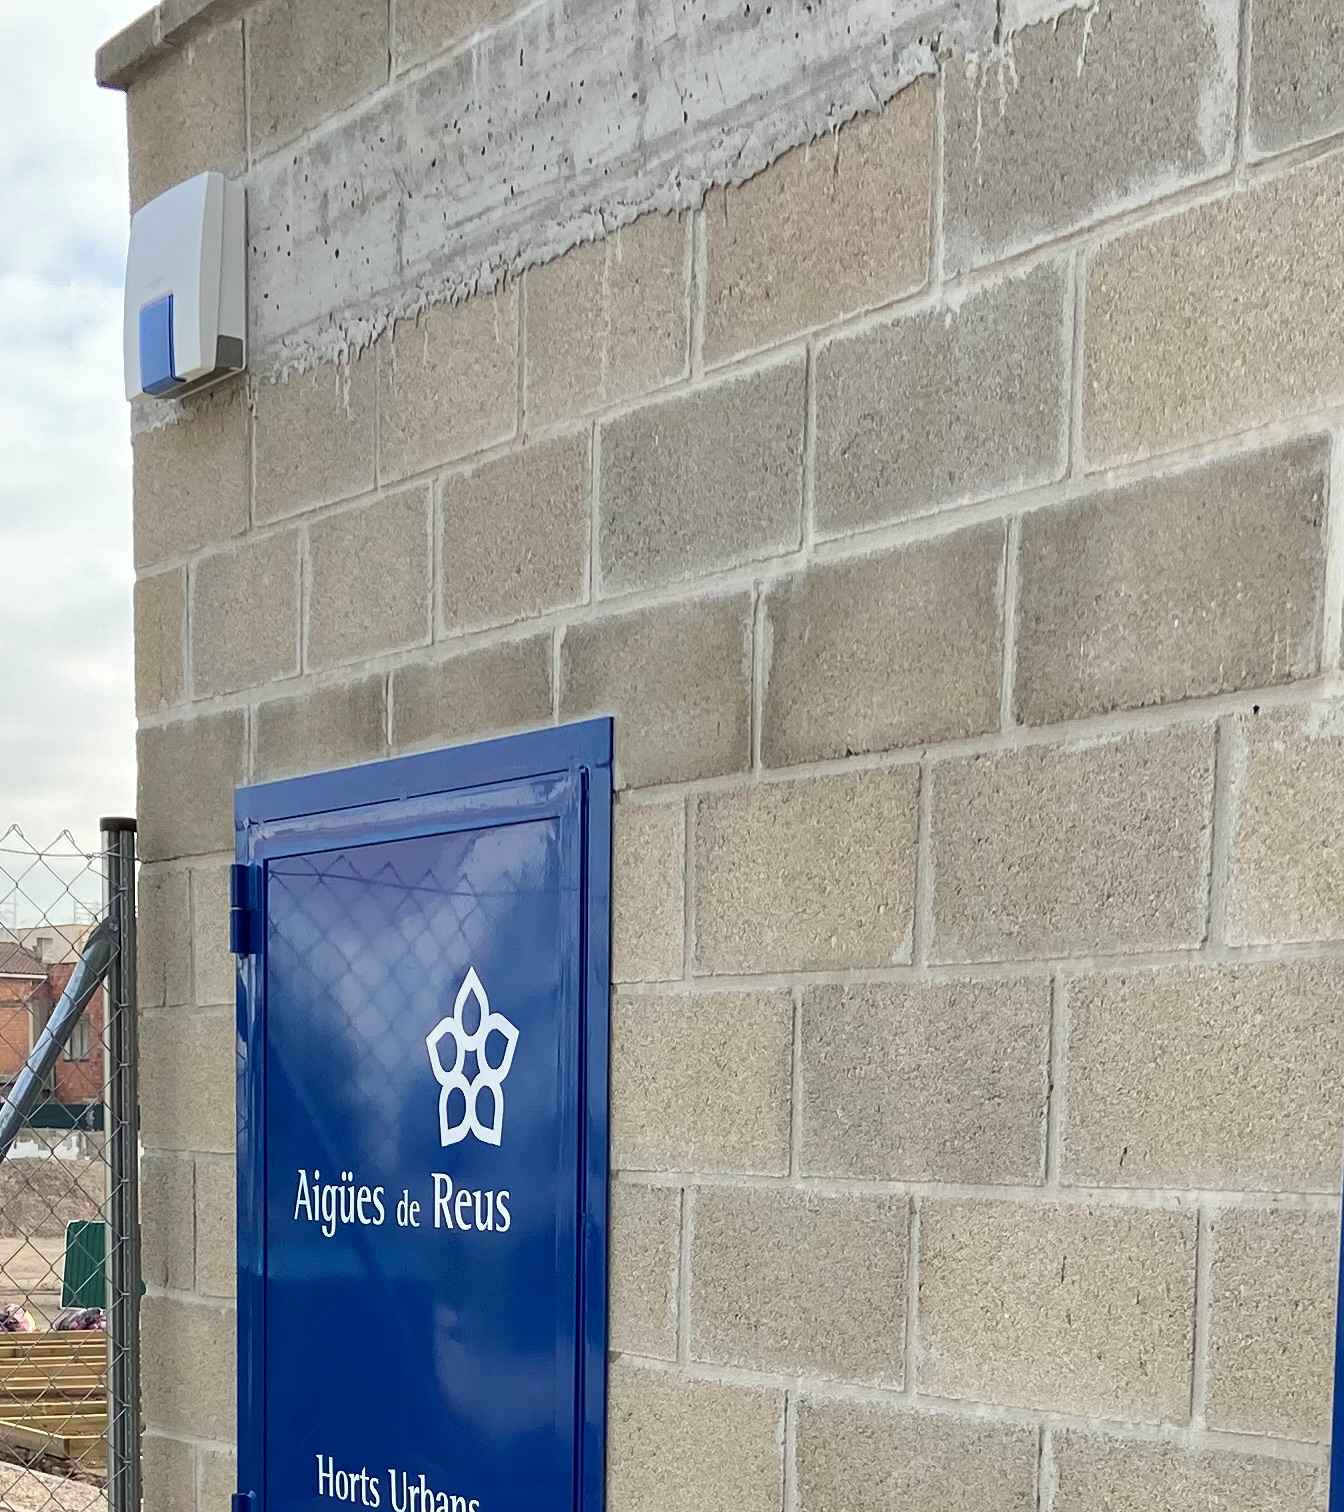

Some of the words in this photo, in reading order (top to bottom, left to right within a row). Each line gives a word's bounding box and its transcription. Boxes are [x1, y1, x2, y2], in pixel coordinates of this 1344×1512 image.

[294, 1168, 385, 1238] Aigües
[396, 1189, 421, 1228] de
[431, 1172, 511, 1233] Reus
[315, 1454, 380, 1508] Horts
